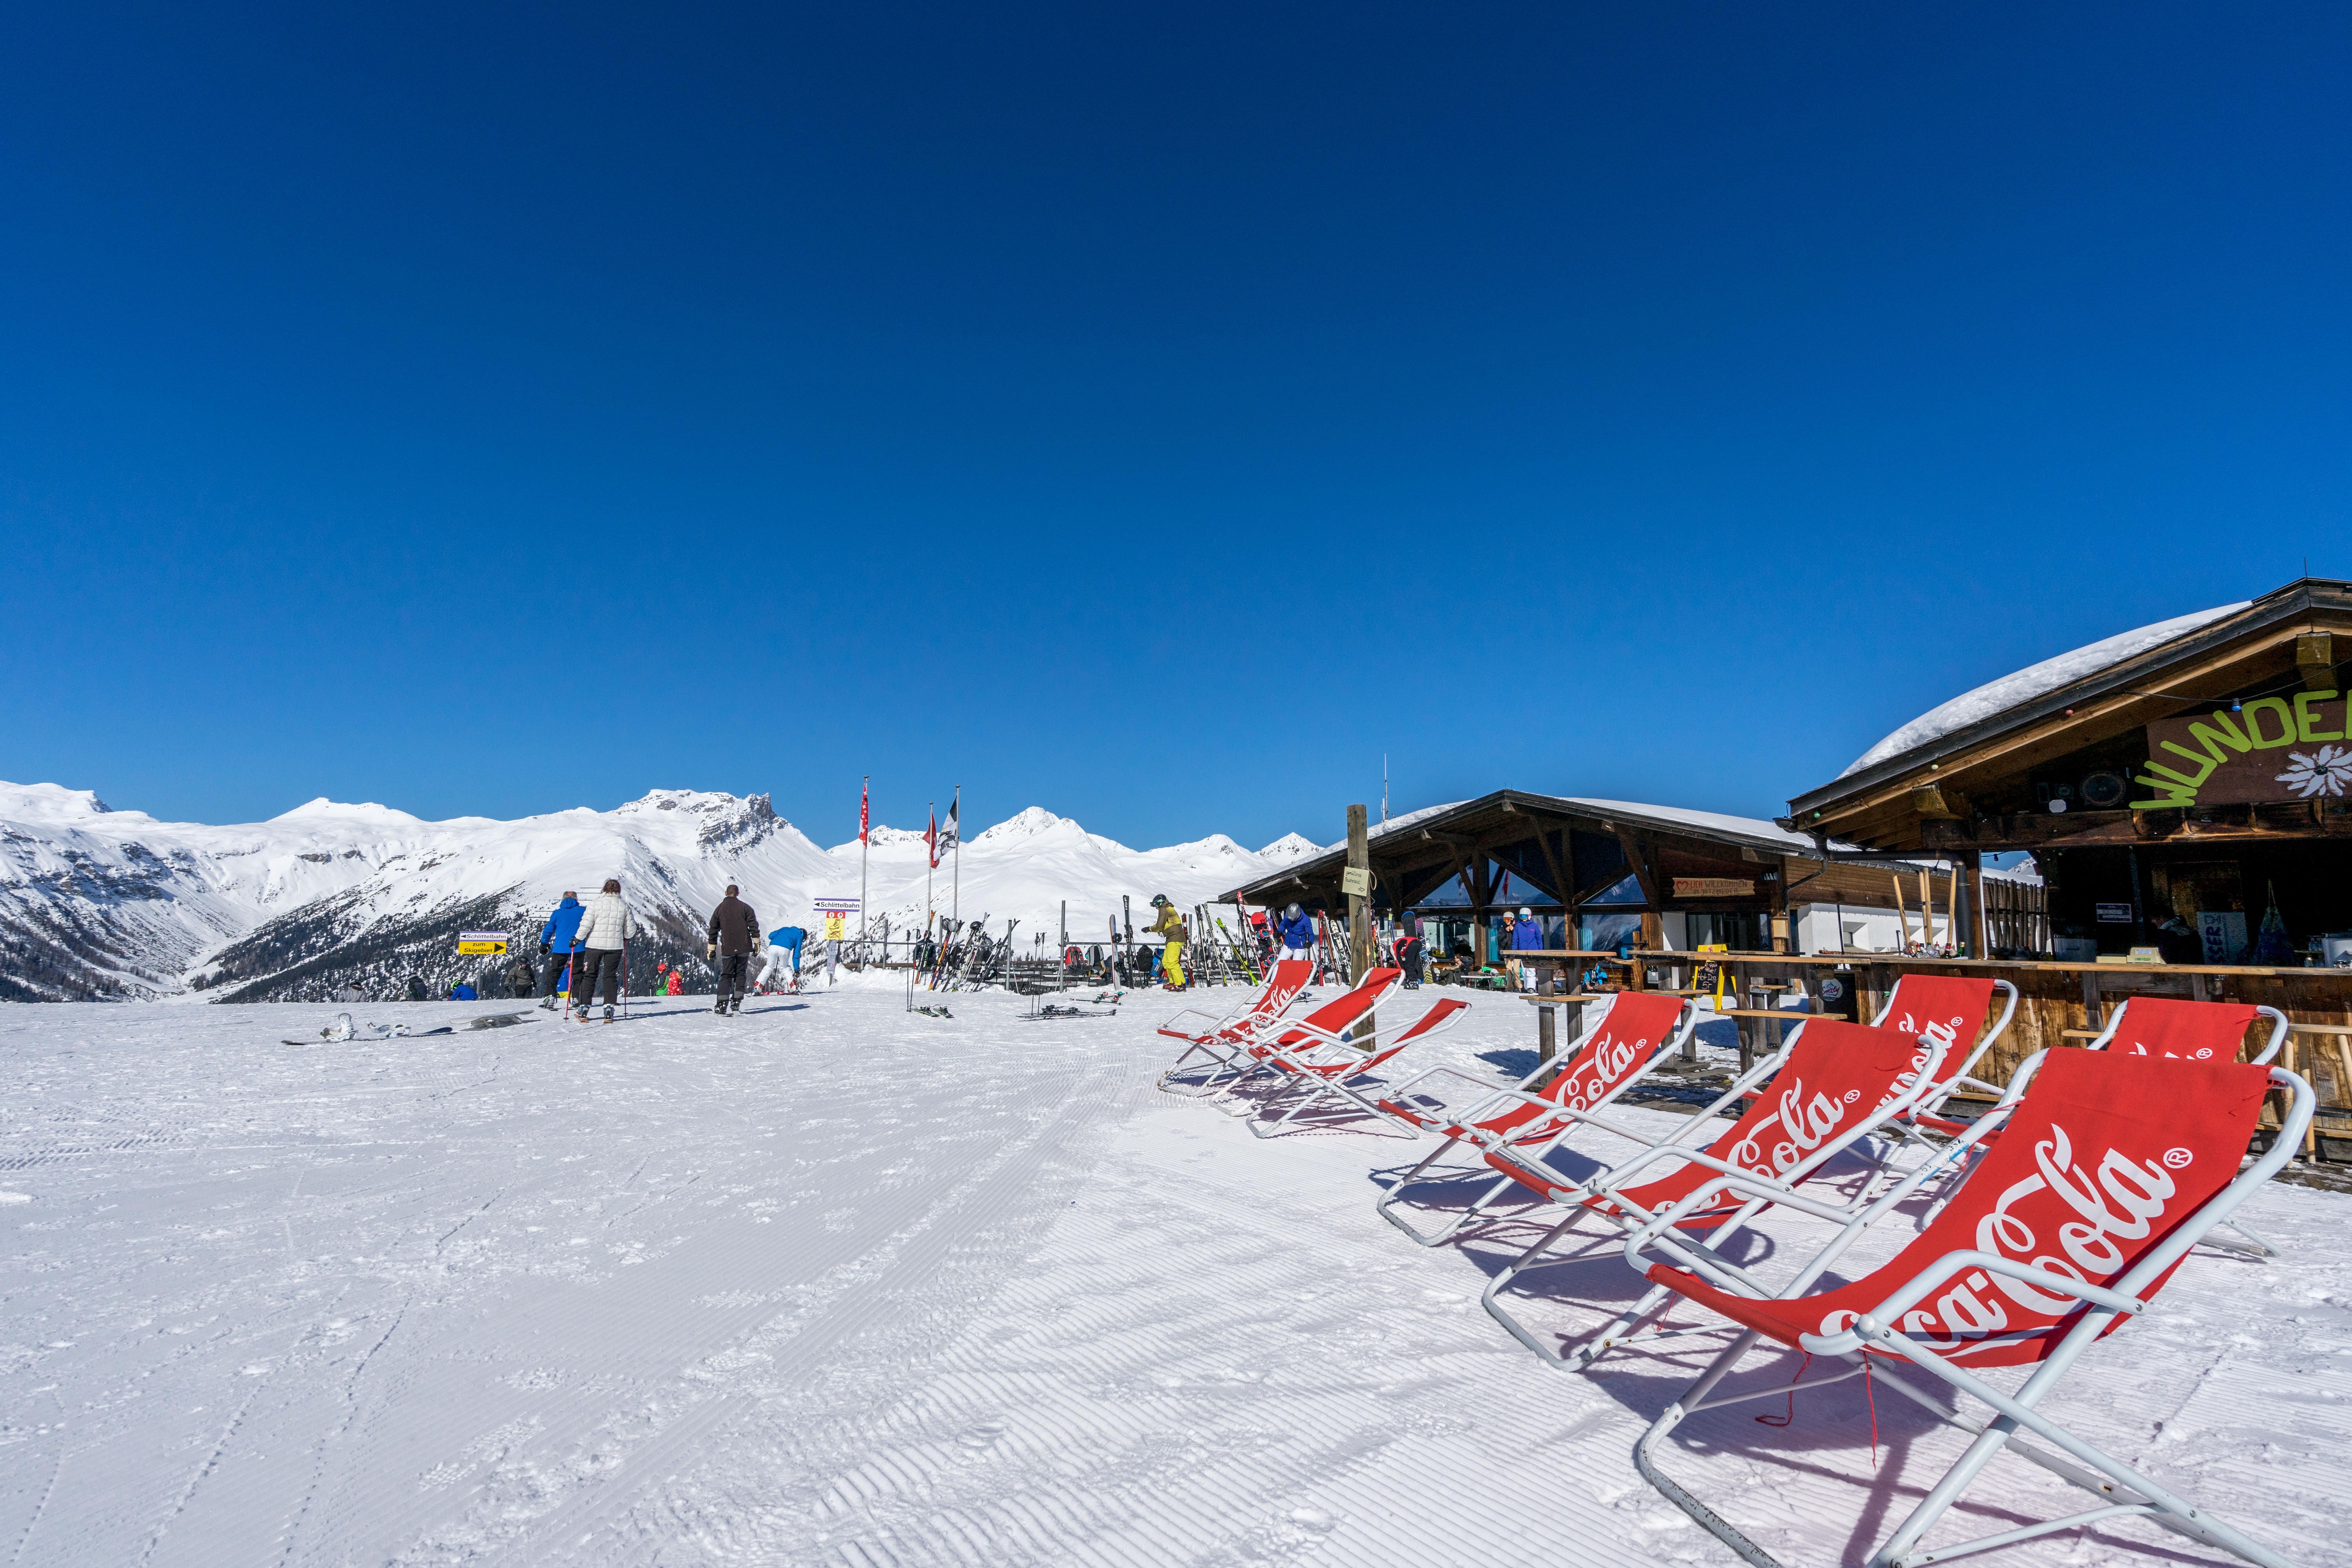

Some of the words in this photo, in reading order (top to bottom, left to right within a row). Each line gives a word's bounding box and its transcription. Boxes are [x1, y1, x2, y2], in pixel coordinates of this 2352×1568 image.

[2129, 689, 2352, 809] WUNDE
[1697, 973, 1707, 981] Hot
[1707, 974, 1717, 983] Dog
